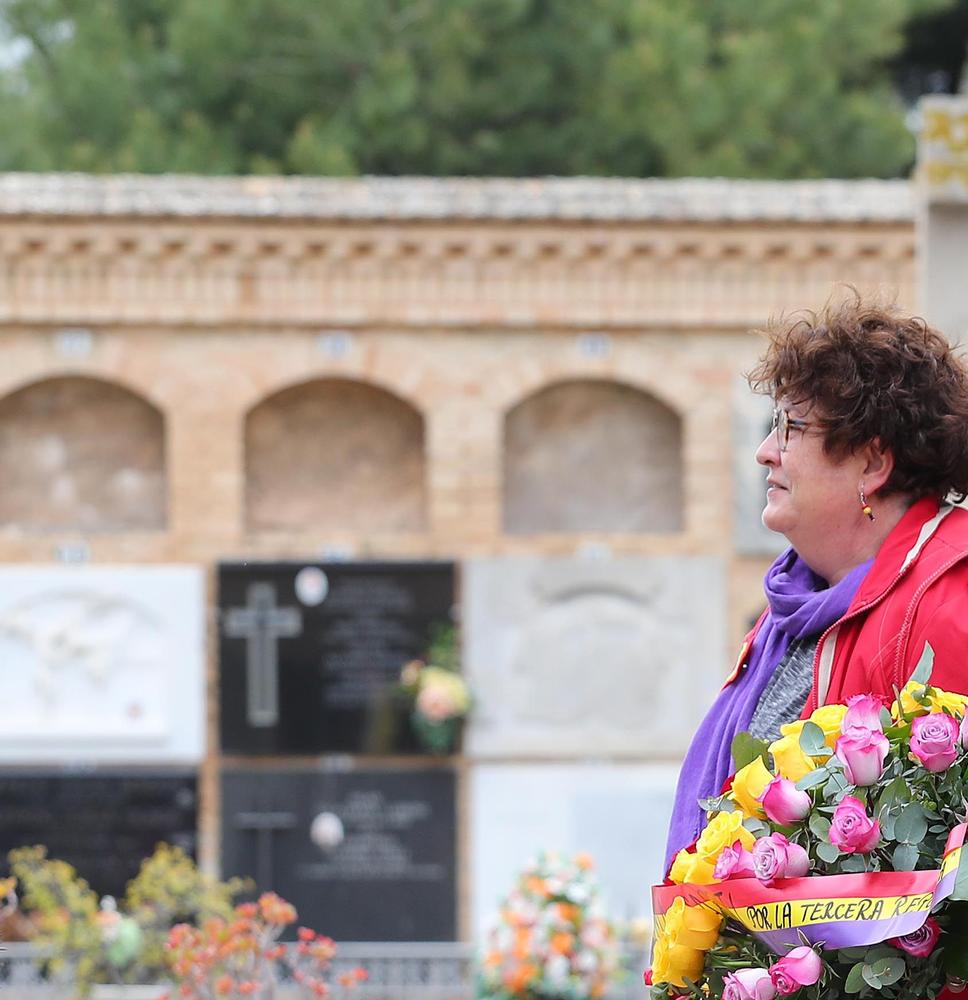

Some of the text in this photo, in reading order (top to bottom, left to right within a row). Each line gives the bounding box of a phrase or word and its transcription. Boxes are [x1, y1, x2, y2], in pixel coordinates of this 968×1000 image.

[746, 905, 772, 930] POR
[775, 902, 792, 929] LA
[801, 898, 884, 922] TERCERA
